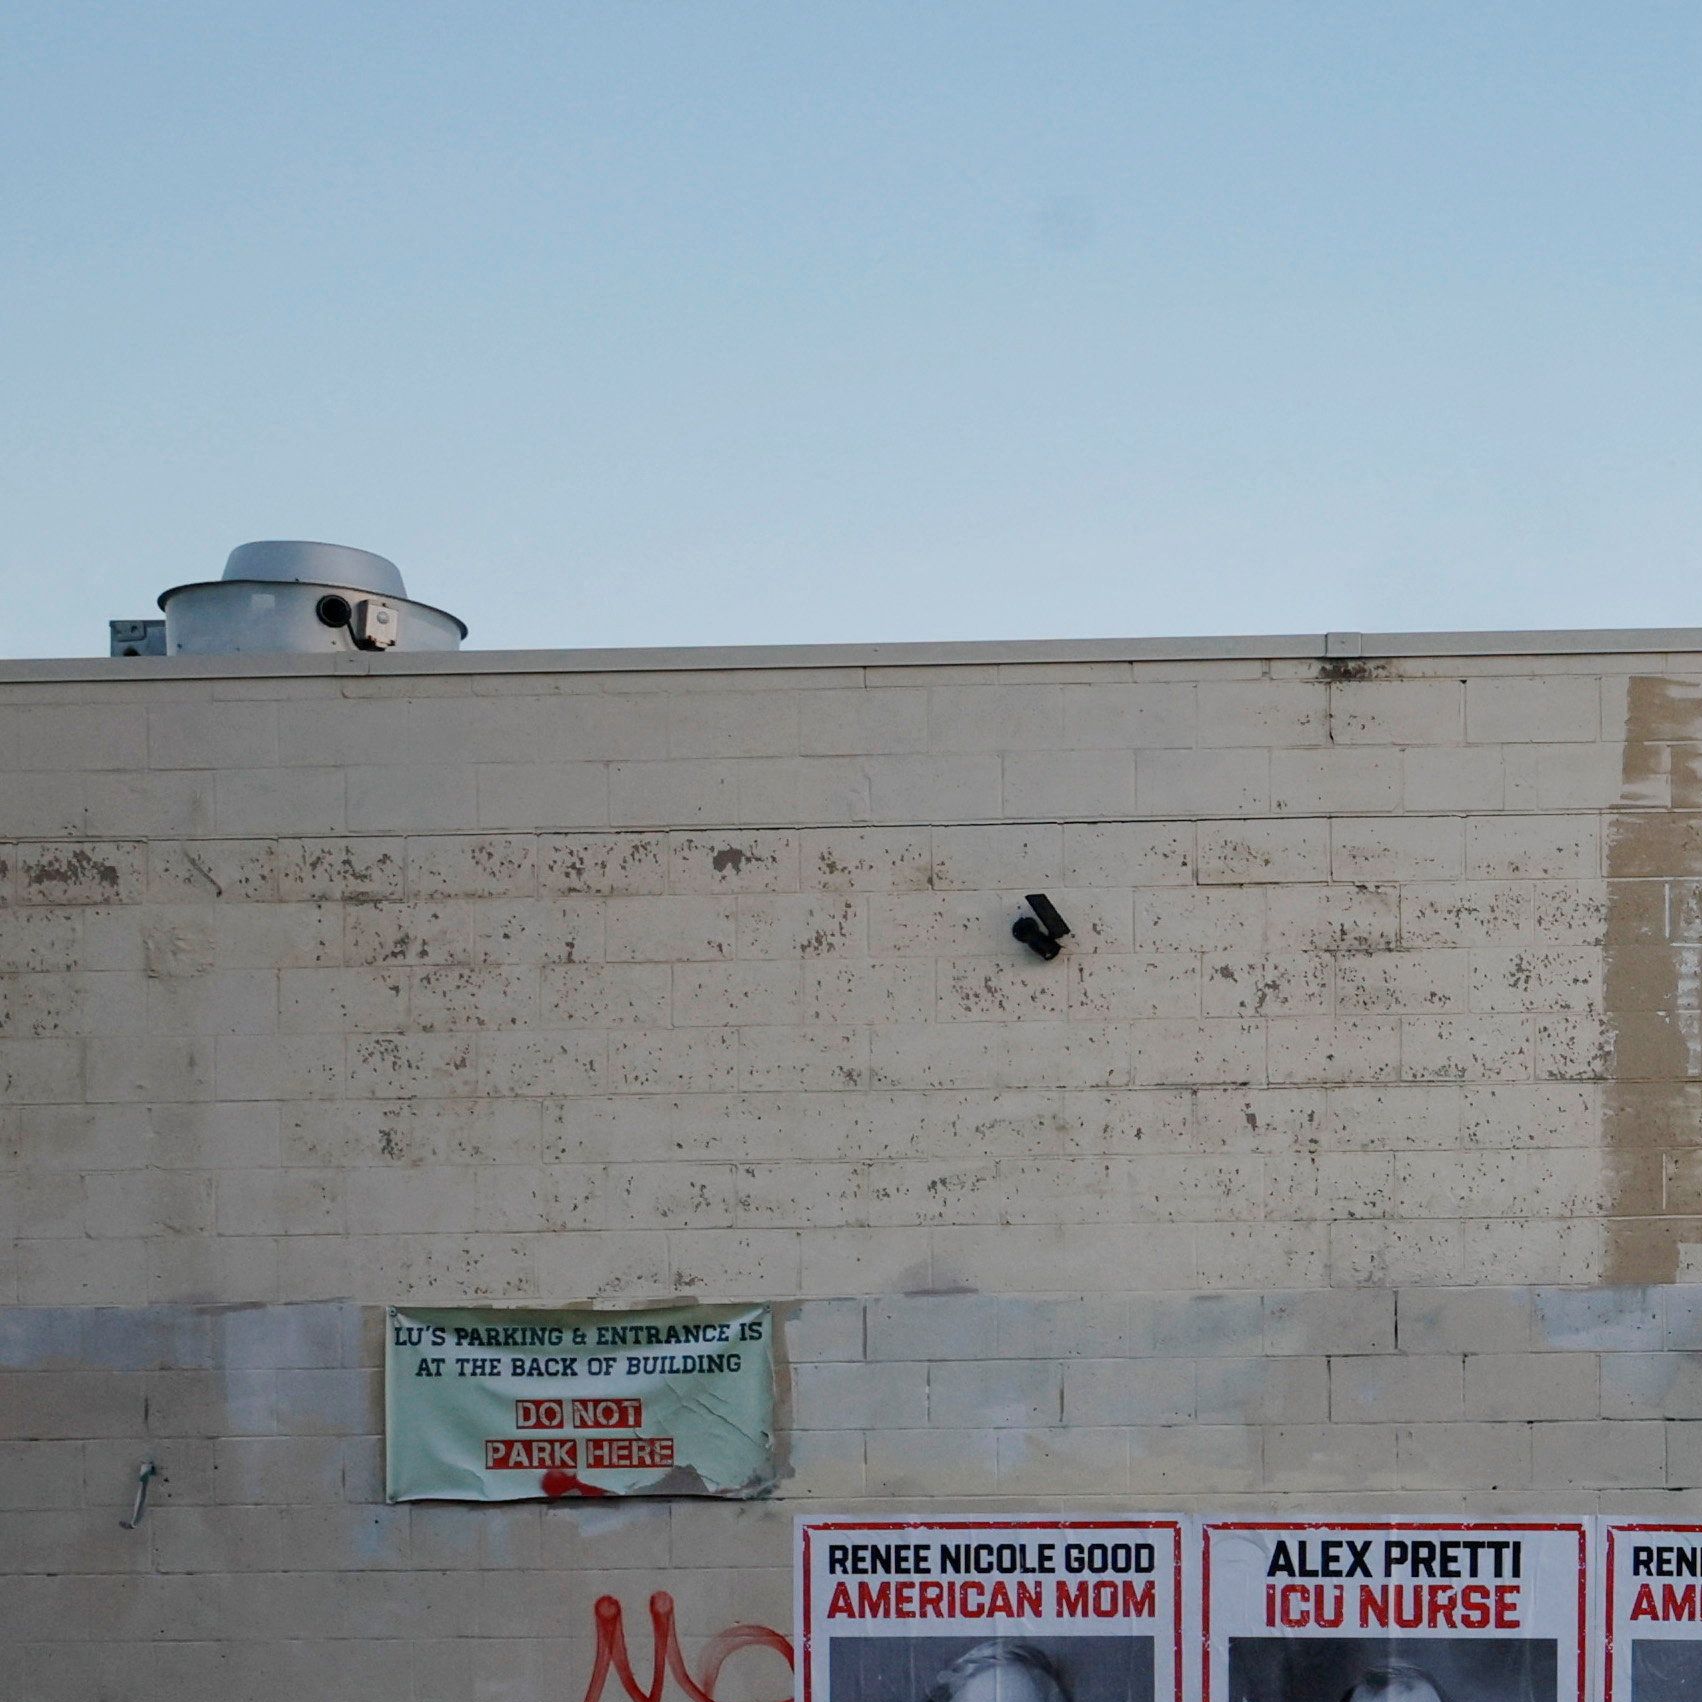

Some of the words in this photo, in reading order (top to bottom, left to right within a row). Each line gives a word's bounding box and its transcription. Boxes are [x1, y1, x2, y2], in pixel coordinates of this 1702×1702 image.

[394, 1327, 446, 1346] LU'S
[455, 1327, 563, 1346] PARKING
[573, 1329, 587, 1345] &
[596, 1324, 730, 1345] ENTRANCE
[739, 1322, 763, 1340] IS
[415, 1358, 445, 1377] AT
[456, 1358, 501, 1377] THE
[511, 1358, 578, 1376] BACK
[588, 1357, 617, 1376] OF
[626, 1353, 742, 1376] BUILDING
[518, 1401, 562, 1426] DO
[574, 1401, 640, 1425] NOT
[487, 1442, 576, 1467] PARK
[588, 1440, 673, 1465] HERE
[829, 1545, 931, 1574] RENEE
[941, 1544, 1055, 1574] NICOLE
[1065, 1543, 1154, 1573] GOOD
[1267, 1540, 1372, 1577] ALEX
[1385, 1541, 1521, 1578] PRETTI
[829, 1581, 1042, 1618] AMERICAN
[1056, 1581, 1154, 1617] MOM
[1267, 1584, 1344, 1627] ICU
[1360, 1585, 1520, 1628] NURSE
